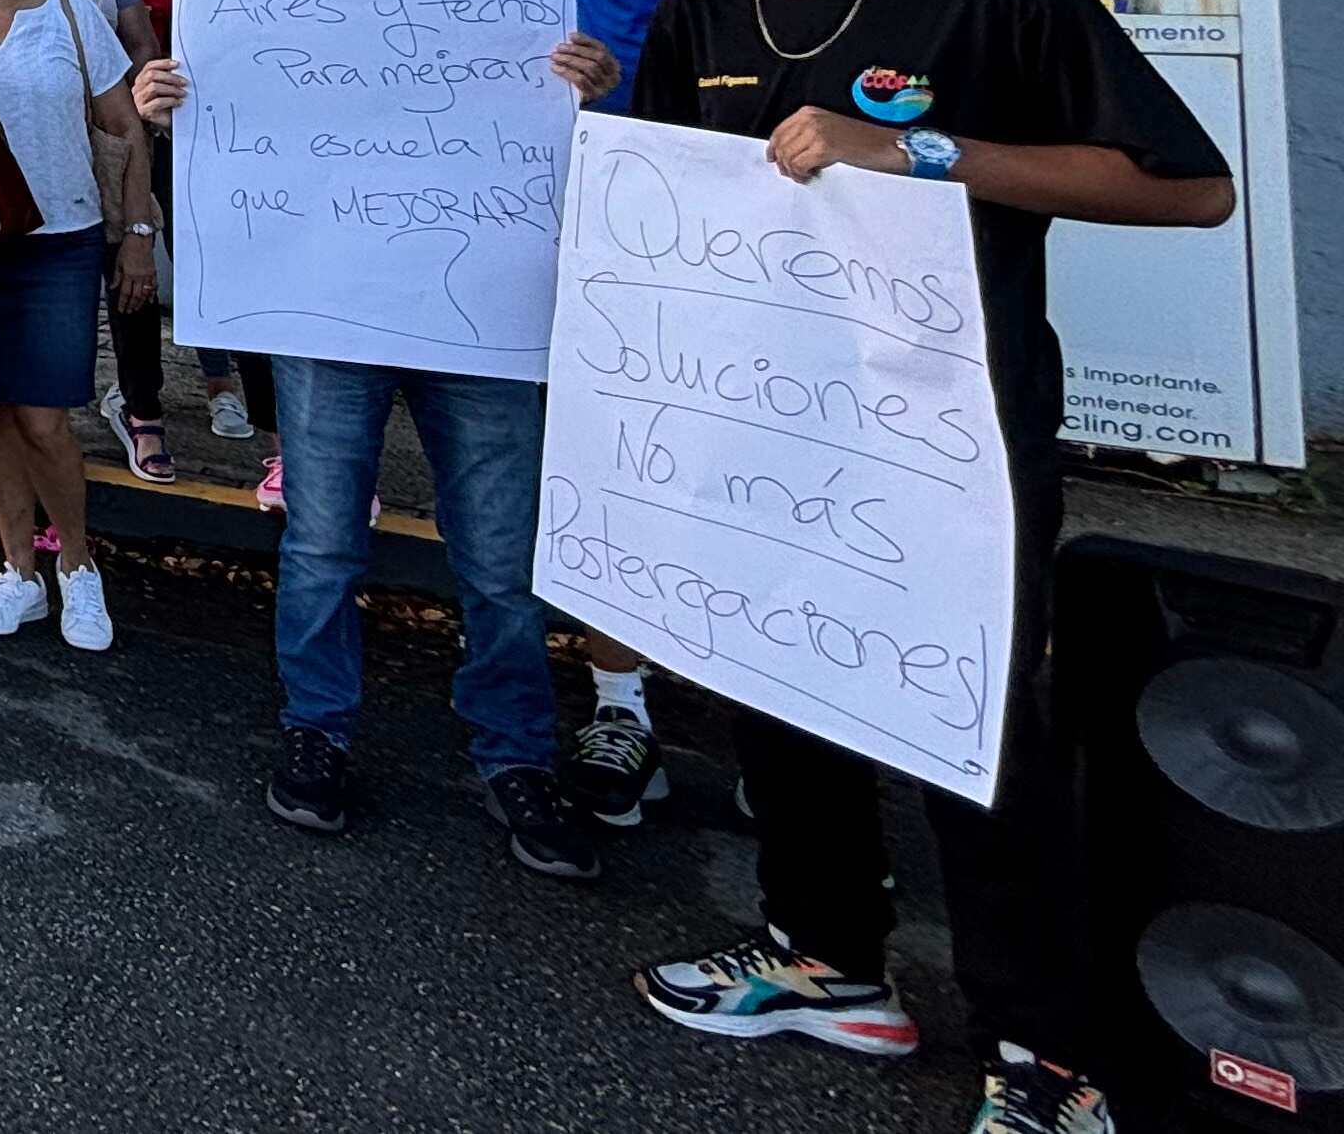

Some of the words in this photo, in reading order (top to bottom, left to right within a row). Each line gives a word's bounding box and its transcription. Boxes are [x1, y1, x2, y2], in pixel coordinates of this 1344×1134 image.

[252, 48, 368, 89] Para
[310, 116, 482, 158] escuela
[493, 120, 556, 206] hay
[230, 188, 305, 240] que
[576, 272, 980, 463] Soluciones
[1083, 366, 1222, 395] Importante.
[1066, 393, 1198, 421] ontenedor.
[1061, 414, 1232, 449] cling.com
[616, 404, 676, 484] No
[724, 467, 905, 563] más
